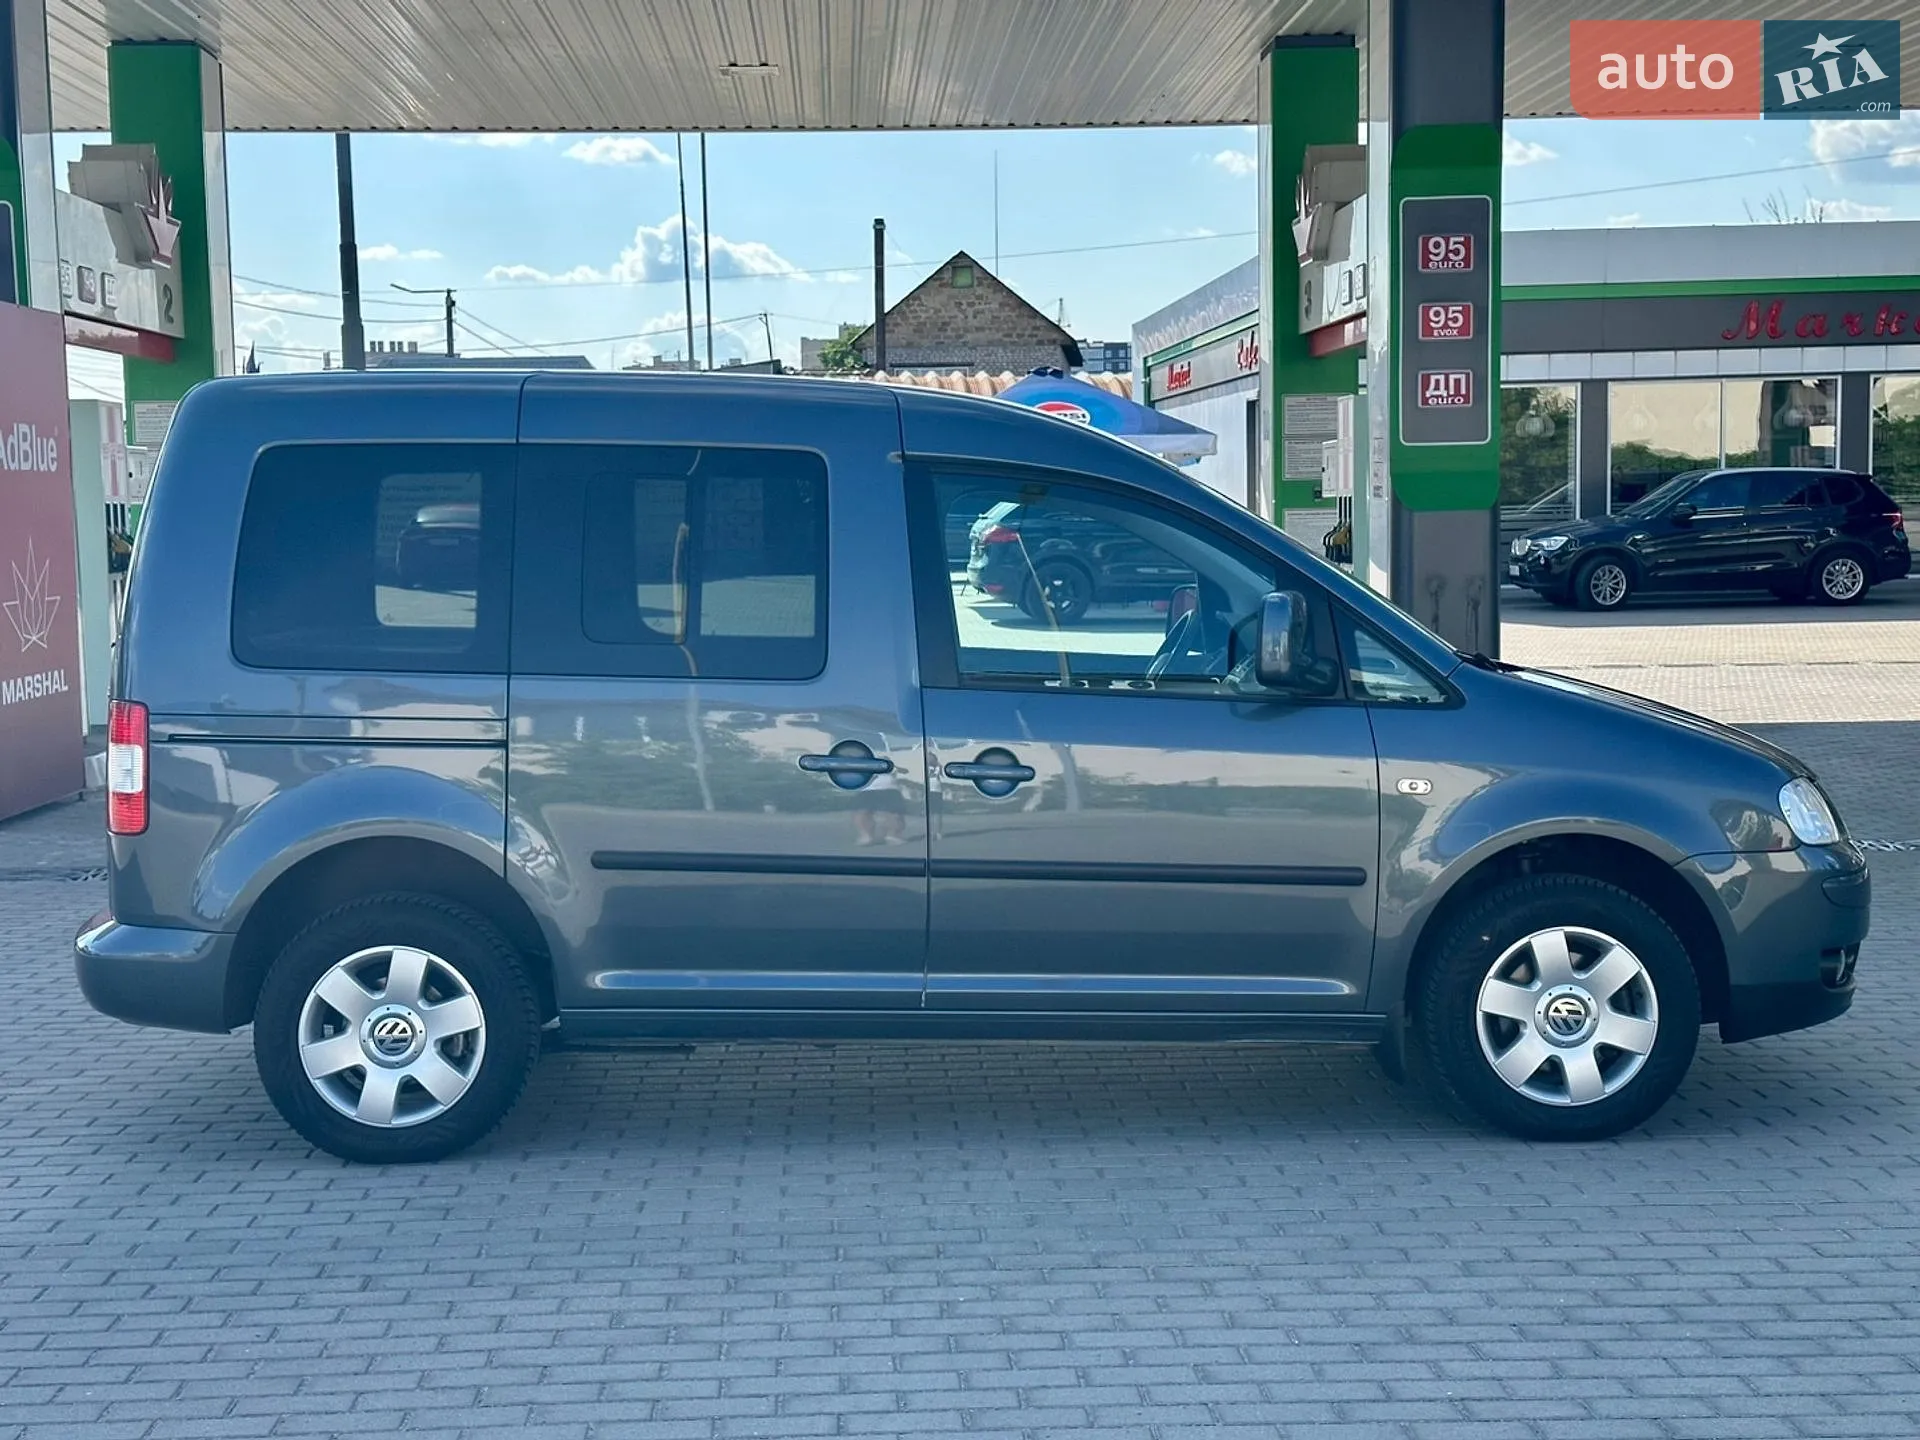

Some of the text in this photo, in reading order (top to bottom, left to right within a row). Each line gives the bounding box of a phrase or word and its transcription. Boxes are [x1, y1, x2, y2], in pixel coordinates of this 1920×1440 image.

[1428, 236, 1466, 262] 95
[1428, 260, 1465, 269] euro
[162, 283, 175, 324] 2
[1304, 280, 1313, 320] 3
[1429, 306, 1464, 328] 95
[1721, 299, 1920, 340] Mark
[1433, 328, 1459, 337] EVOX
[1425, 373, 1467, 397] ДП
[1428, 395, 1464, 405] euro
[2, 668, 69, 706] MARSHAL
